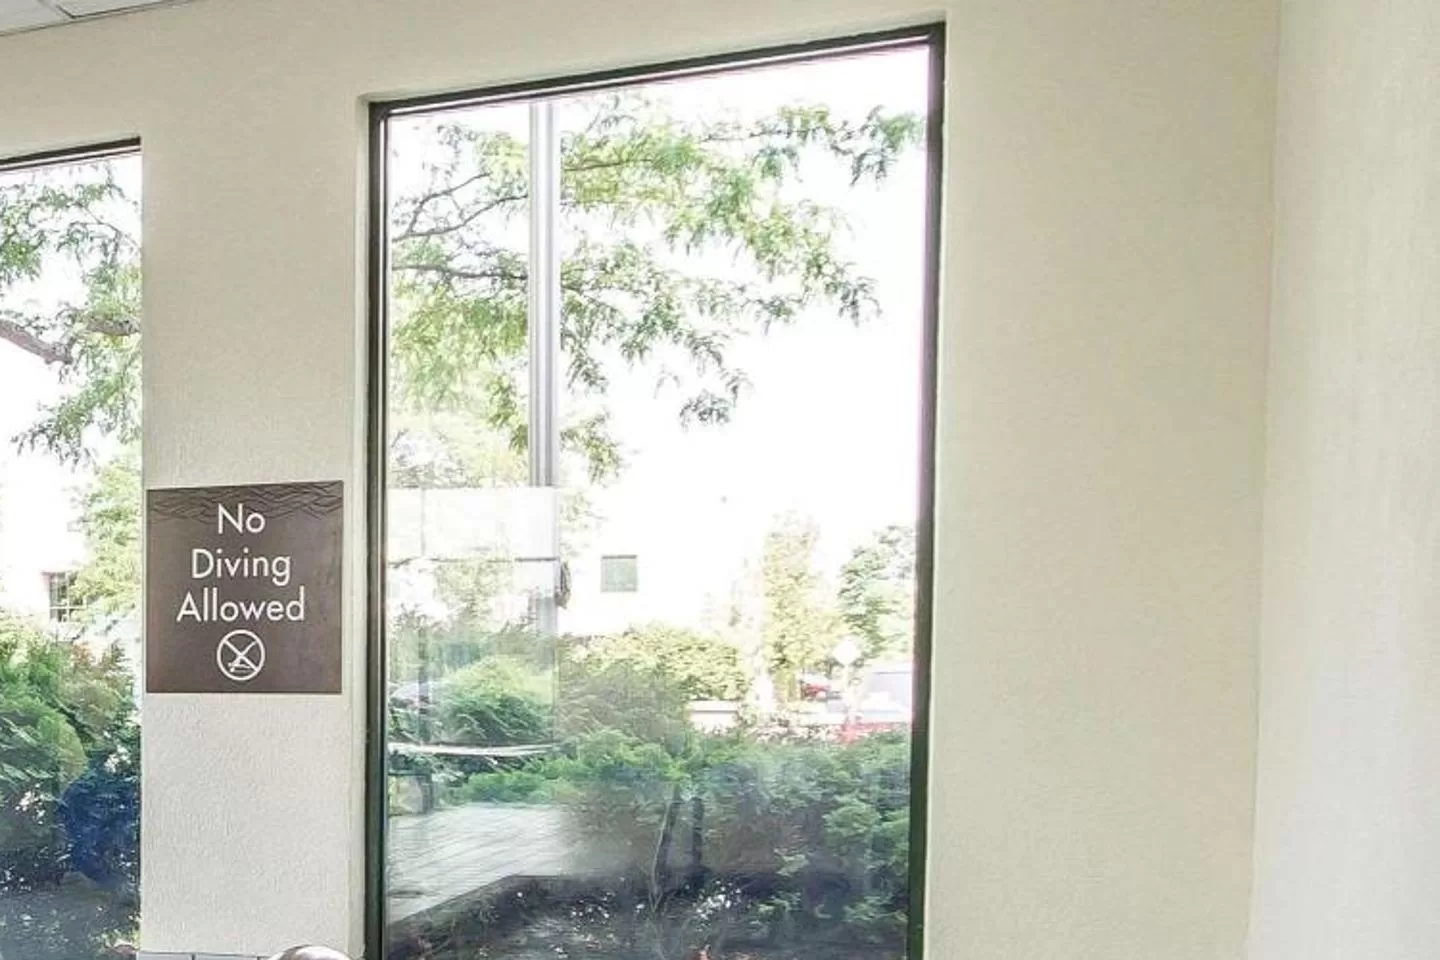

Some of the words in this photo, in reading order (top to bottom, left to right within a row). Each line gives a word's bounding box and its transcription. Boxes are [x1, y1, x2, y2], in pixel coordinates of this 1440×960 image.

[217, 503, 266, 535] No
[191, 547, 291, 587] Diving
[176, 584, 305, 622] Allowed
